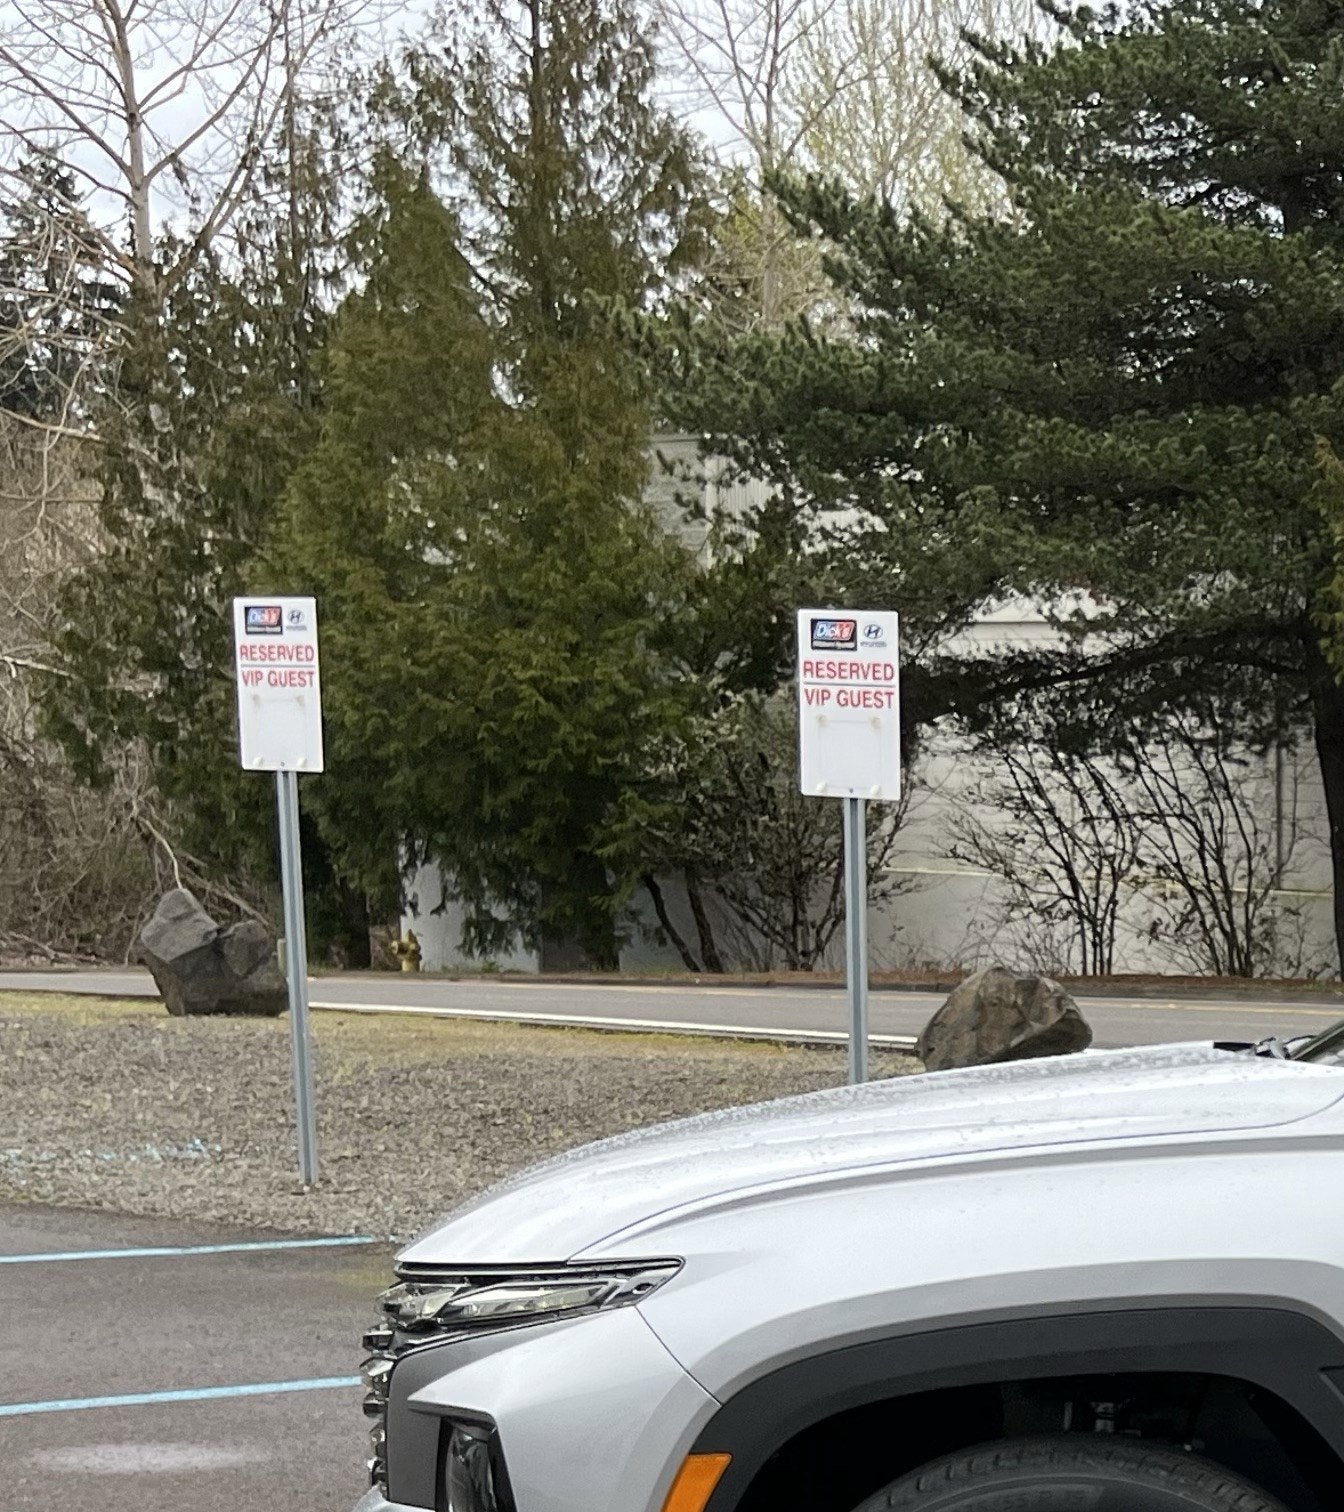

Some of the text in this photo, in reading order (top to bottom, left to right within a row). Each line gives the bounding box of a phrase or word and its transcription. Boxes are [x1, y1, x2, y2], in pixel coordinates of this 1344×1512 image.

[239, 645, 315, 662] RESERVED
[241, 670, 315, 688] VIP GUEST
[803, 660, 895, 681] RESERVED
[804, 688, 895, 709] VIP GUEST
